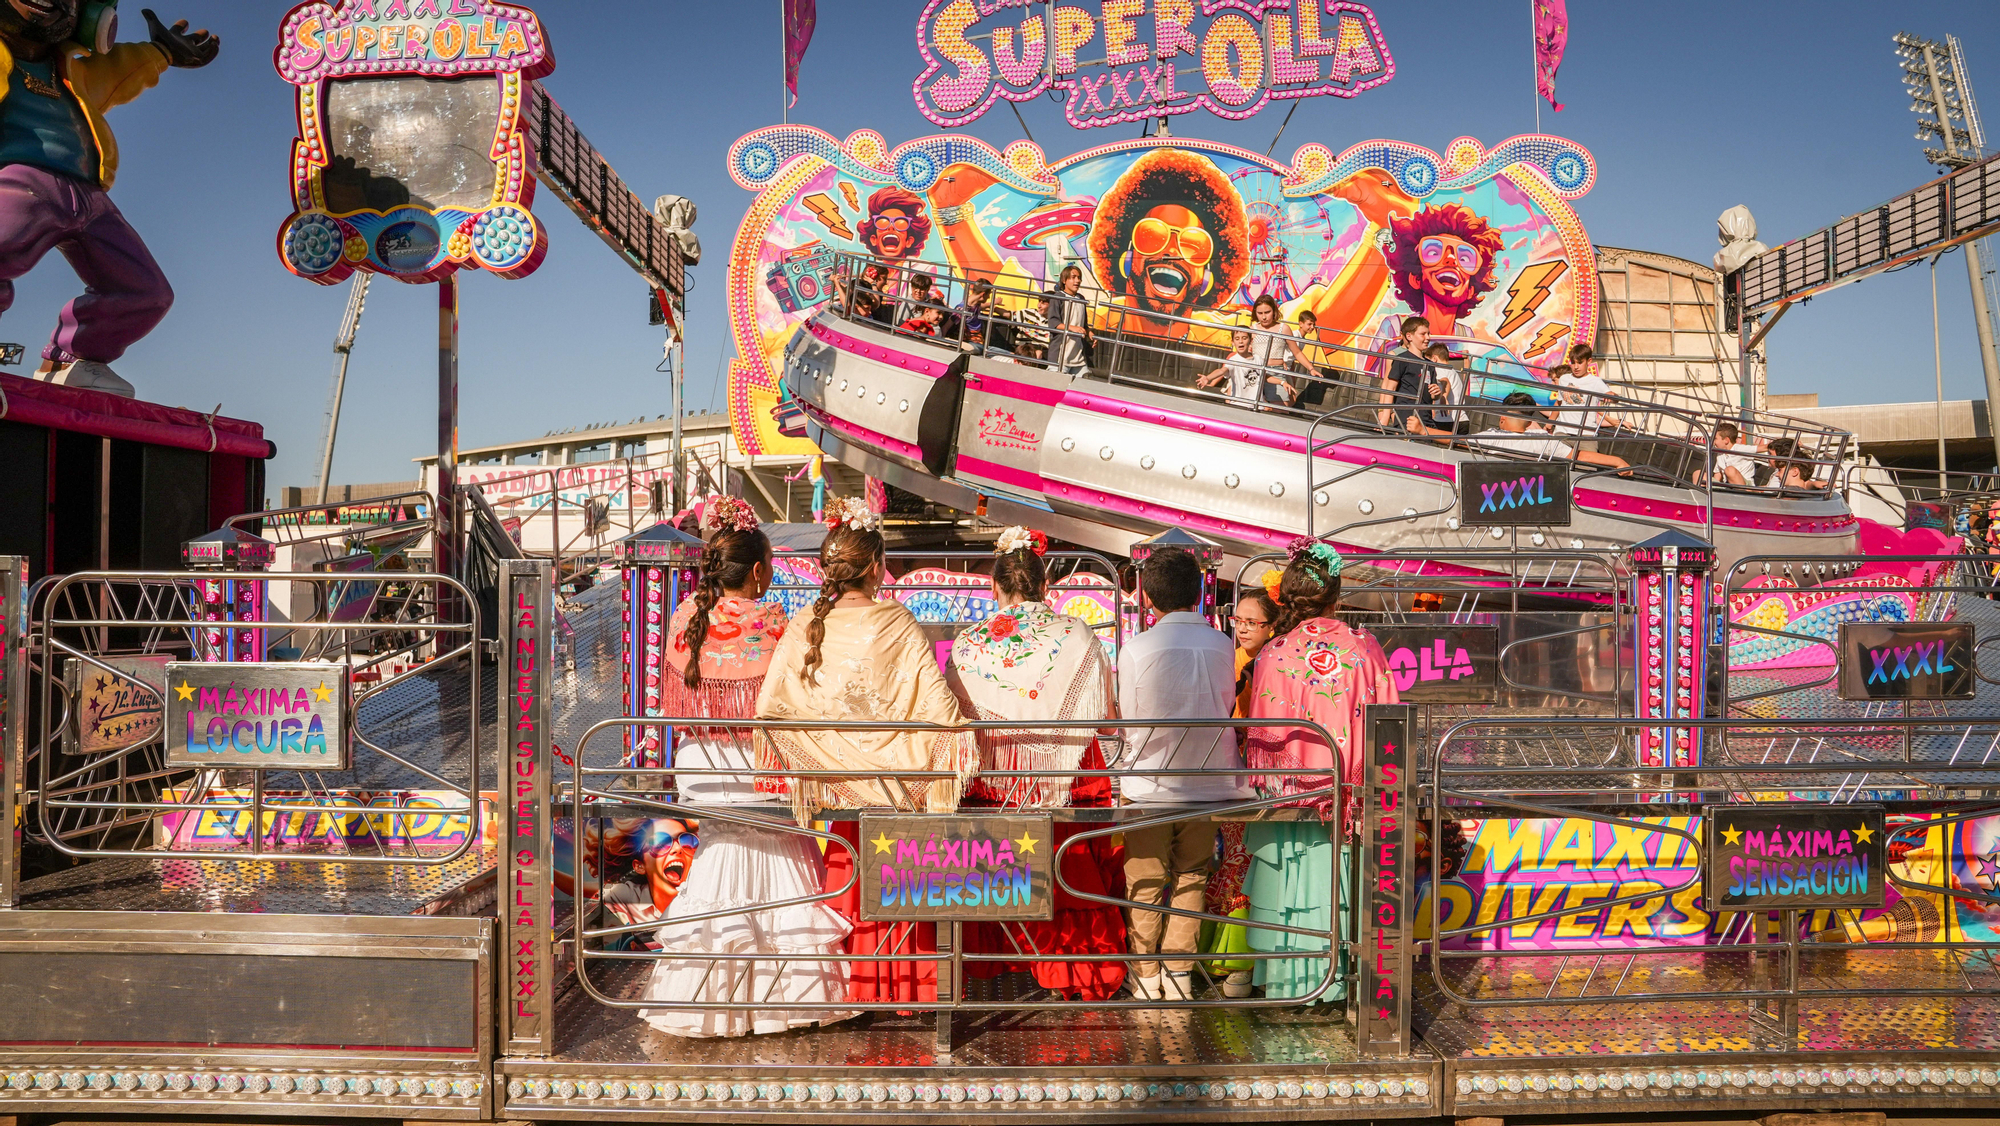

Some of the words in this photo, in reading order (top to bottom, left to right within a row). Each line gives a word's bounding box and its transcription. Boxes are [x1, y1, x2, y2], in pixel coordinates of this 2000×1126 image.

[1079, 62, 1189, 116] XXXL
[338, 506, 391, 526] BRUJA
[1479, 474, 1553, 514] XXXL
[192, 546, 220, 557] XXXL
[239, 546, 268, 557] SUPER
[638, 545, 667, 557] XXXL
[1634, 551, 1661, 562] OLLA
[1680, 551, 1707, 562] XXXL
[517, 592, 535, 629] LA
[516, 637, 535, 732] NUEVA
[1388, 638, 1475, 692] OLLA
[1867, 639, 1954, 685] XXXL
[198, 680, 311, 716] MÁXIMA
[186, 710, 328, 755] LOCURA
[515, 741, 534, 838] SUPER
[896, 832, 1015, 868] MÁXIMA
[1379, 762, 1398, 893] SUPER
[1743, 823, 1853, 858] MÁXIMA
[516, 849, 535, 926] OLLA
[880, 862, 1032, 907] DIVERSIÓN
[1728, 852, 1868, 897] SENSACIÓN
[1375, 902, 1395, 1000] OLLA
[516, 939, 535, 1018] XXXL
